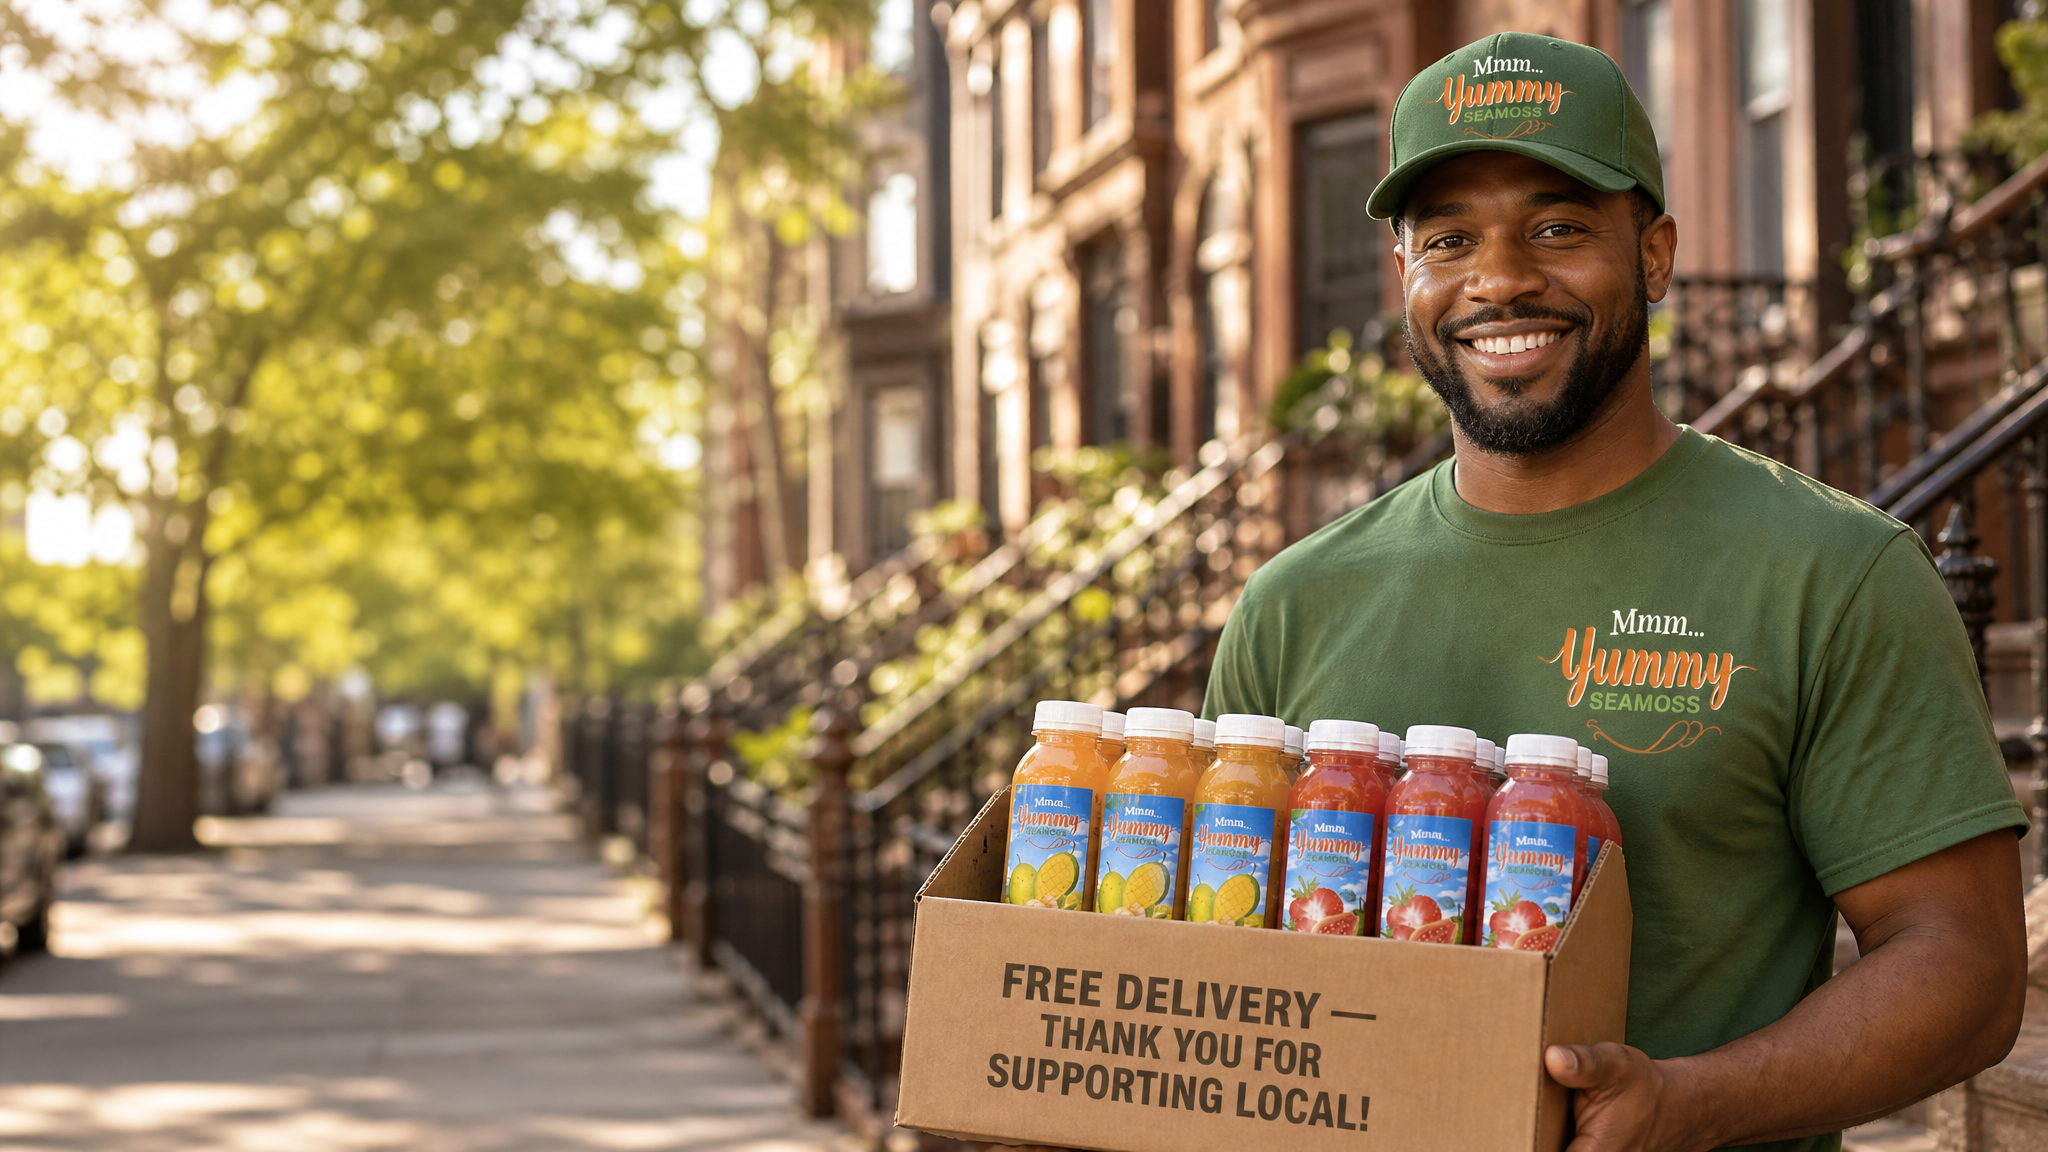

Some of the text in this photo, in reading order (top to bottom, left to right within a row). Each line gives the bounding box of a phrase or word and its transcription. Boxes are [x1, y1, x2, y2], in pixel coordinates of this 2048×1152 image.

[1472, 56, 1544, 78] Mmm...
[1427, 74, 1577, 125] Yummy
[1463, 106, 1542, 124] SEAMOSS
[1610, 608, 1705, 637] Mmm...
[1537, 626, 1758, 710] Yummy
[1589, 691, 1700, 714] SEAMOSS
[1017, 803, 1089, 836] Yummy
[1108, 812, 1177, 845] Yummy
[1195, 823, 1271, 857] Yummy
[1392, 835, 1468, 869] Yummy
[1496, 842, 1572, 876] Yummy
[1002, 963, 1102, 1007] FREE
[1115, 973, 1321, 1029] DELIVERY
[1040, 1014, 1322, 1078] THANK YOU FOR
[987, 1053, 1371, 1132] SUPPORTING LOCAL!
